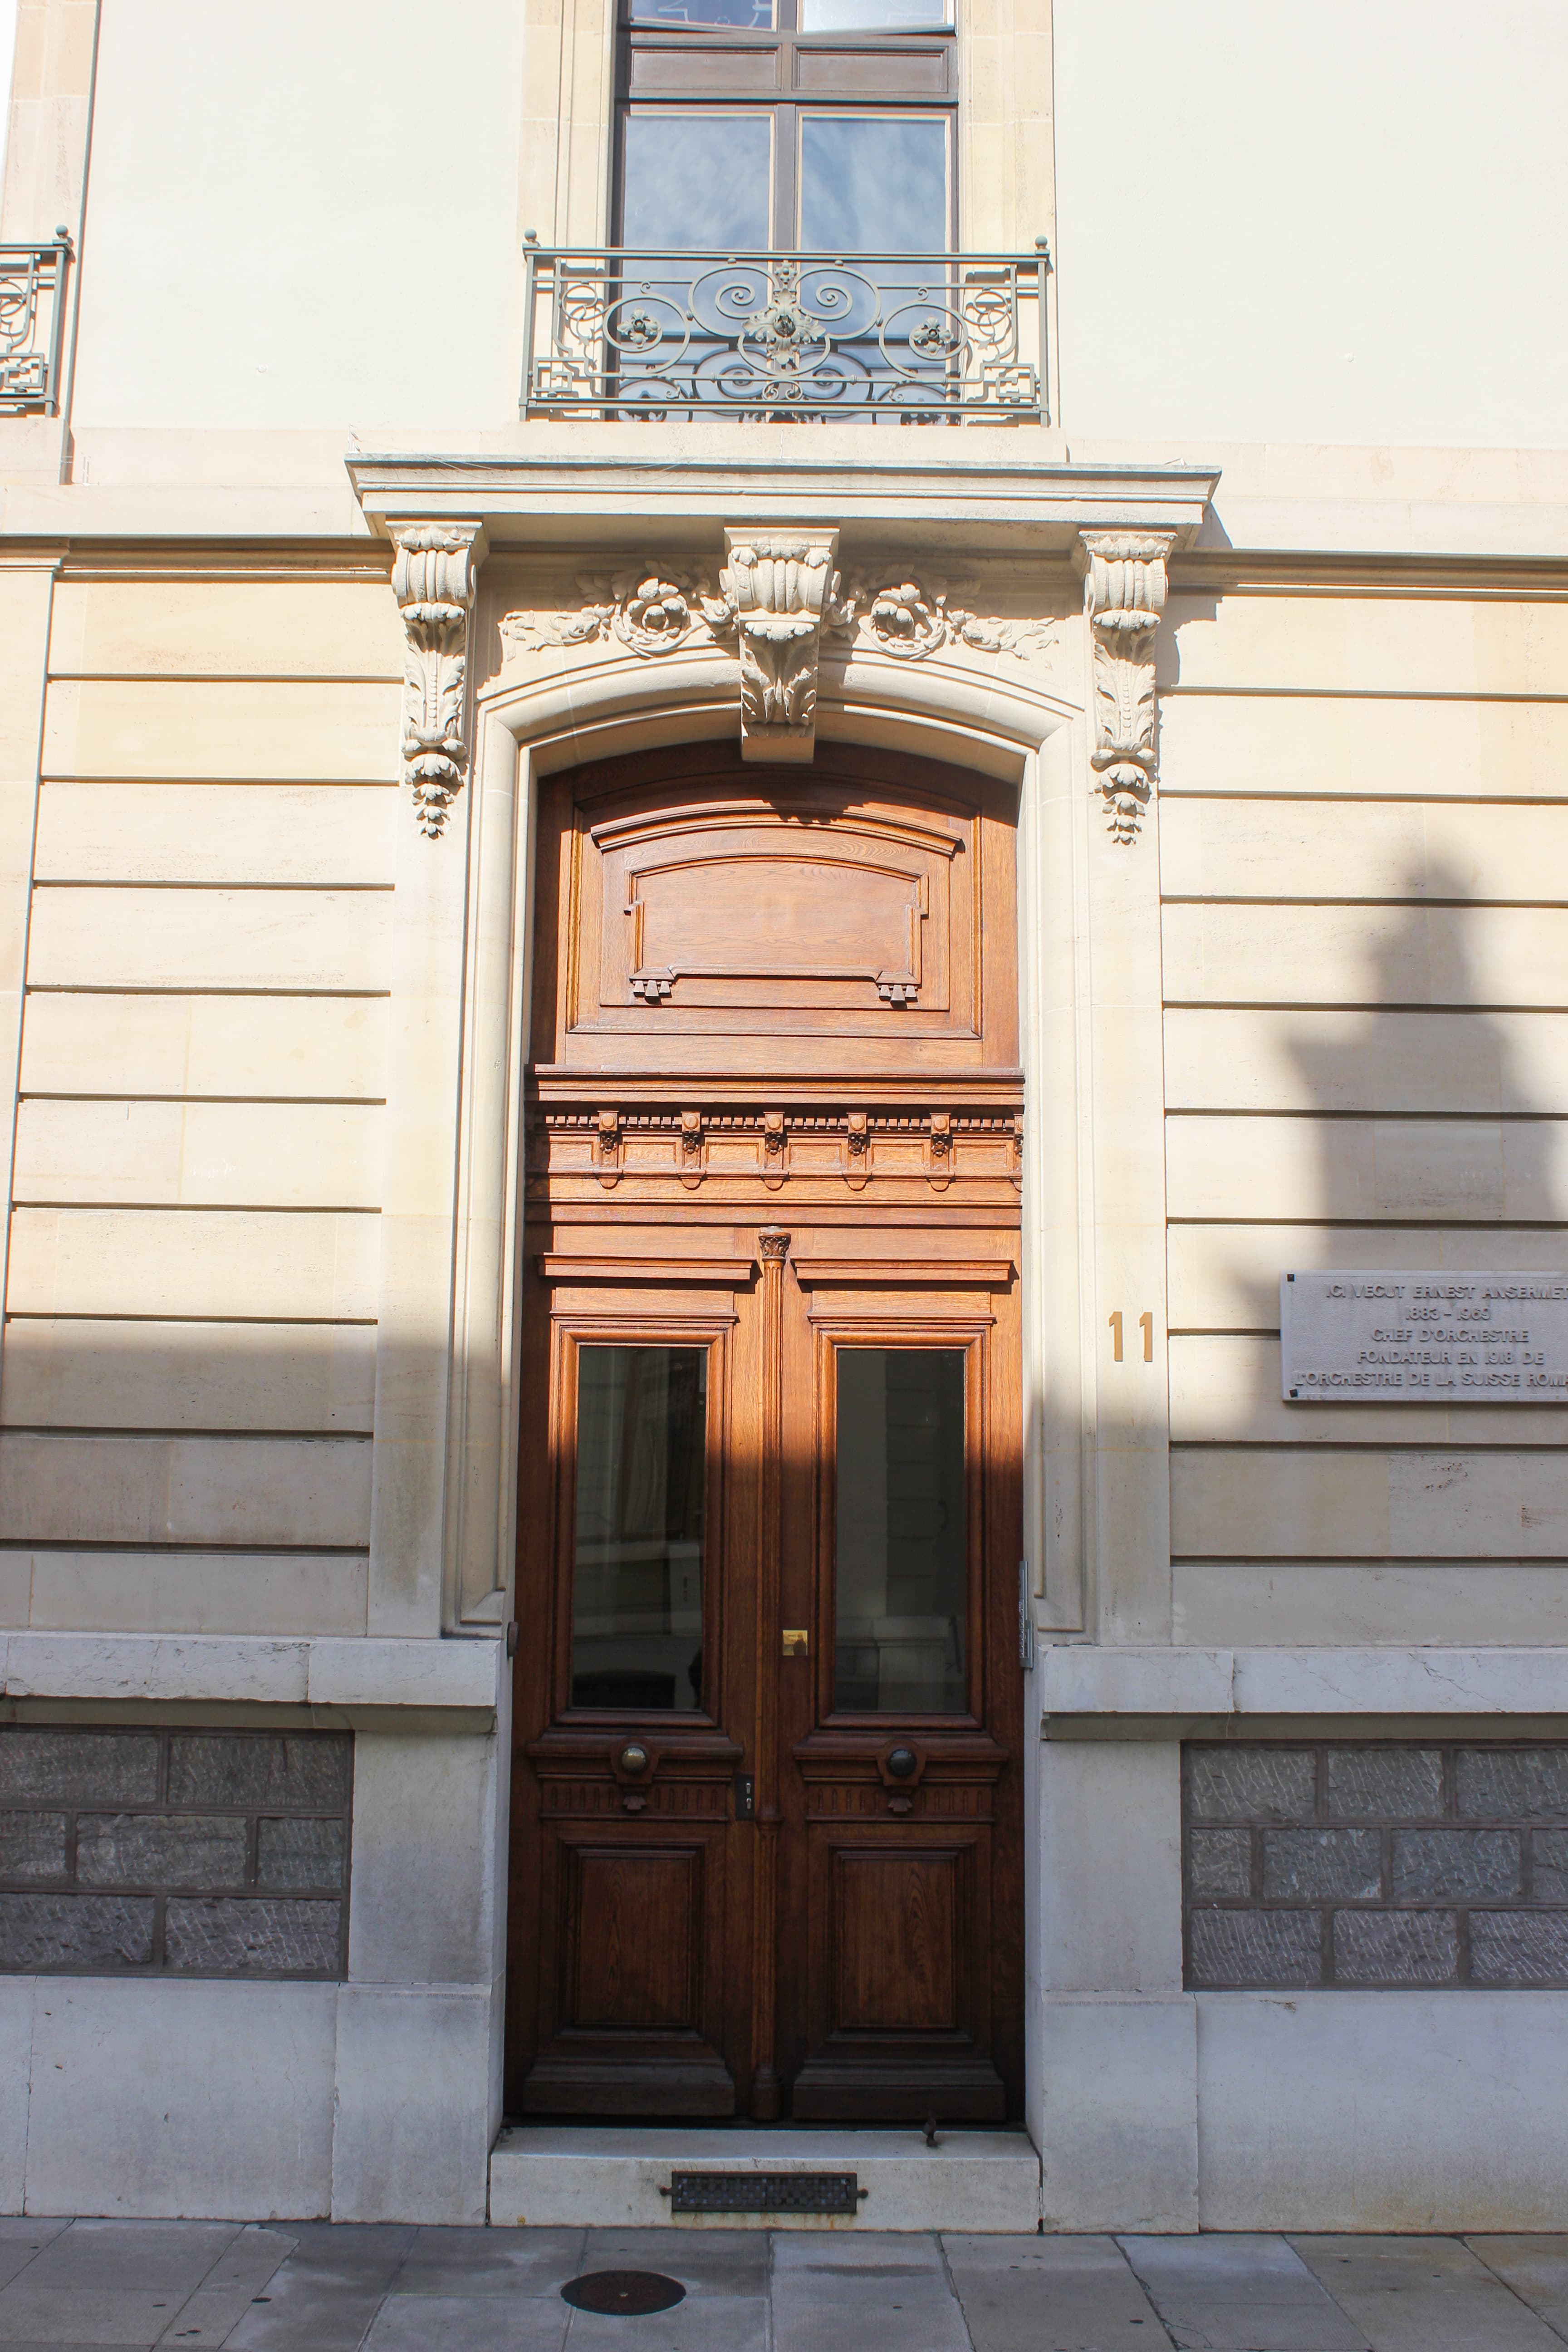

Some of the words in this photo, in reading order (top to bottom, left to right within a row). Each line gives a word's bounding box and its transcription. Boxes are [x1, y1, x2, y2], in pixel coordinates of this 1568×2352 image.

[1326, 1284, 1346, 1298] ICI
[1412, 1284, 1475, 1299] ERNEST
[1482, 1284, 1568, 1299] ANSERMET
[1405, 1306, 1440, 1320] 1883
[1457, 1307, 1490, 1321] 1969
[1109, 1311, 1152, 1362] 11
[1372, 1328, 1412, 1342] CHEF
[1419, 1328, 1529, 1343] D'ORCHESTRE
[1357, 1350, 1452, 1364] FONDATEUR
[1457, 1351, 1478, 1364] EN
[1485, 1351, 1514, 1365] 1918
[1522, 1351, 1544, 1365] DE
[1294, 1371, 1402, 1386] L'ORCHESTRE
[1409, 1372, 1430, 1387] DE
[1436, 1372, 1457, 1387] LA
[1461, 1372, 1520, 1387] SUISSE
